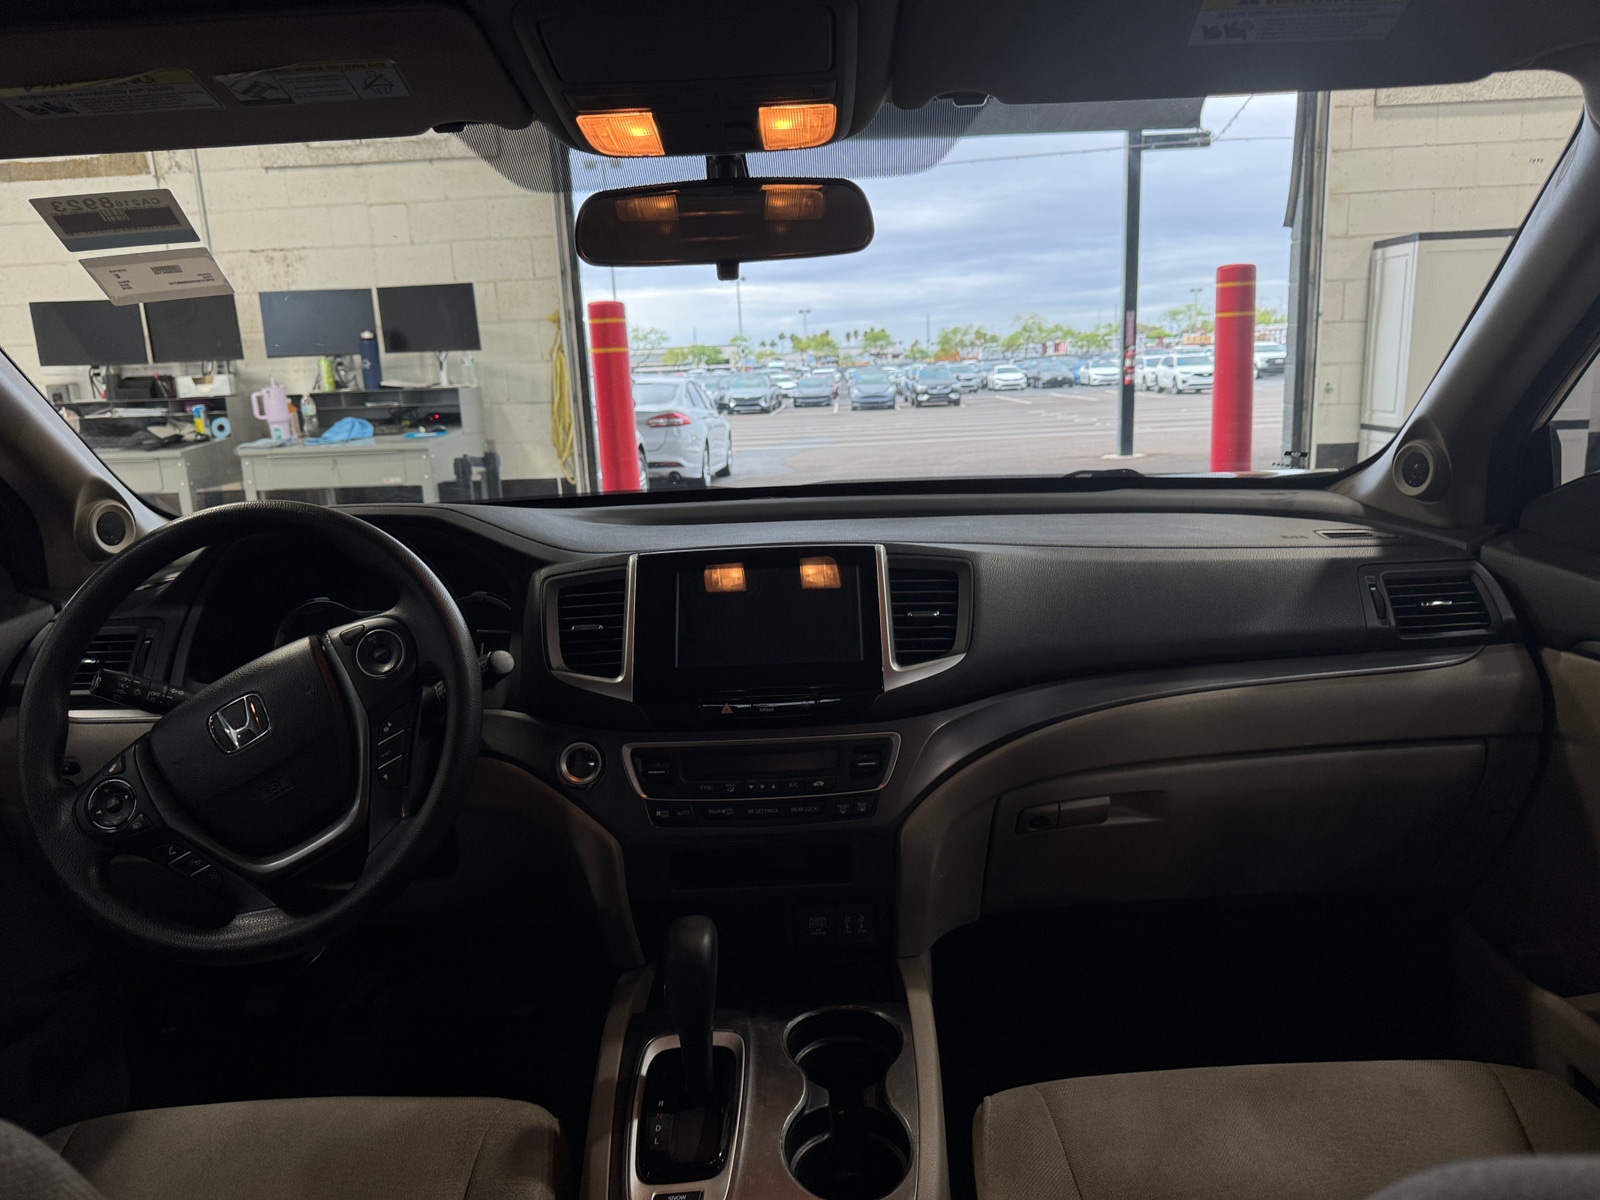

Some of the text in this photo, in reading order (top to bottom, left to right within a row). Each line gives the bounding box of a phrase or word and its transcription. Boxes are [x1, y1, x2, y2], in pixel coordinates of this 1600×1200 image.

[657, 1099, 665, 1107] R
[654, 1124, 662, 1132] D
[653, 1136, 660, 1145] L
